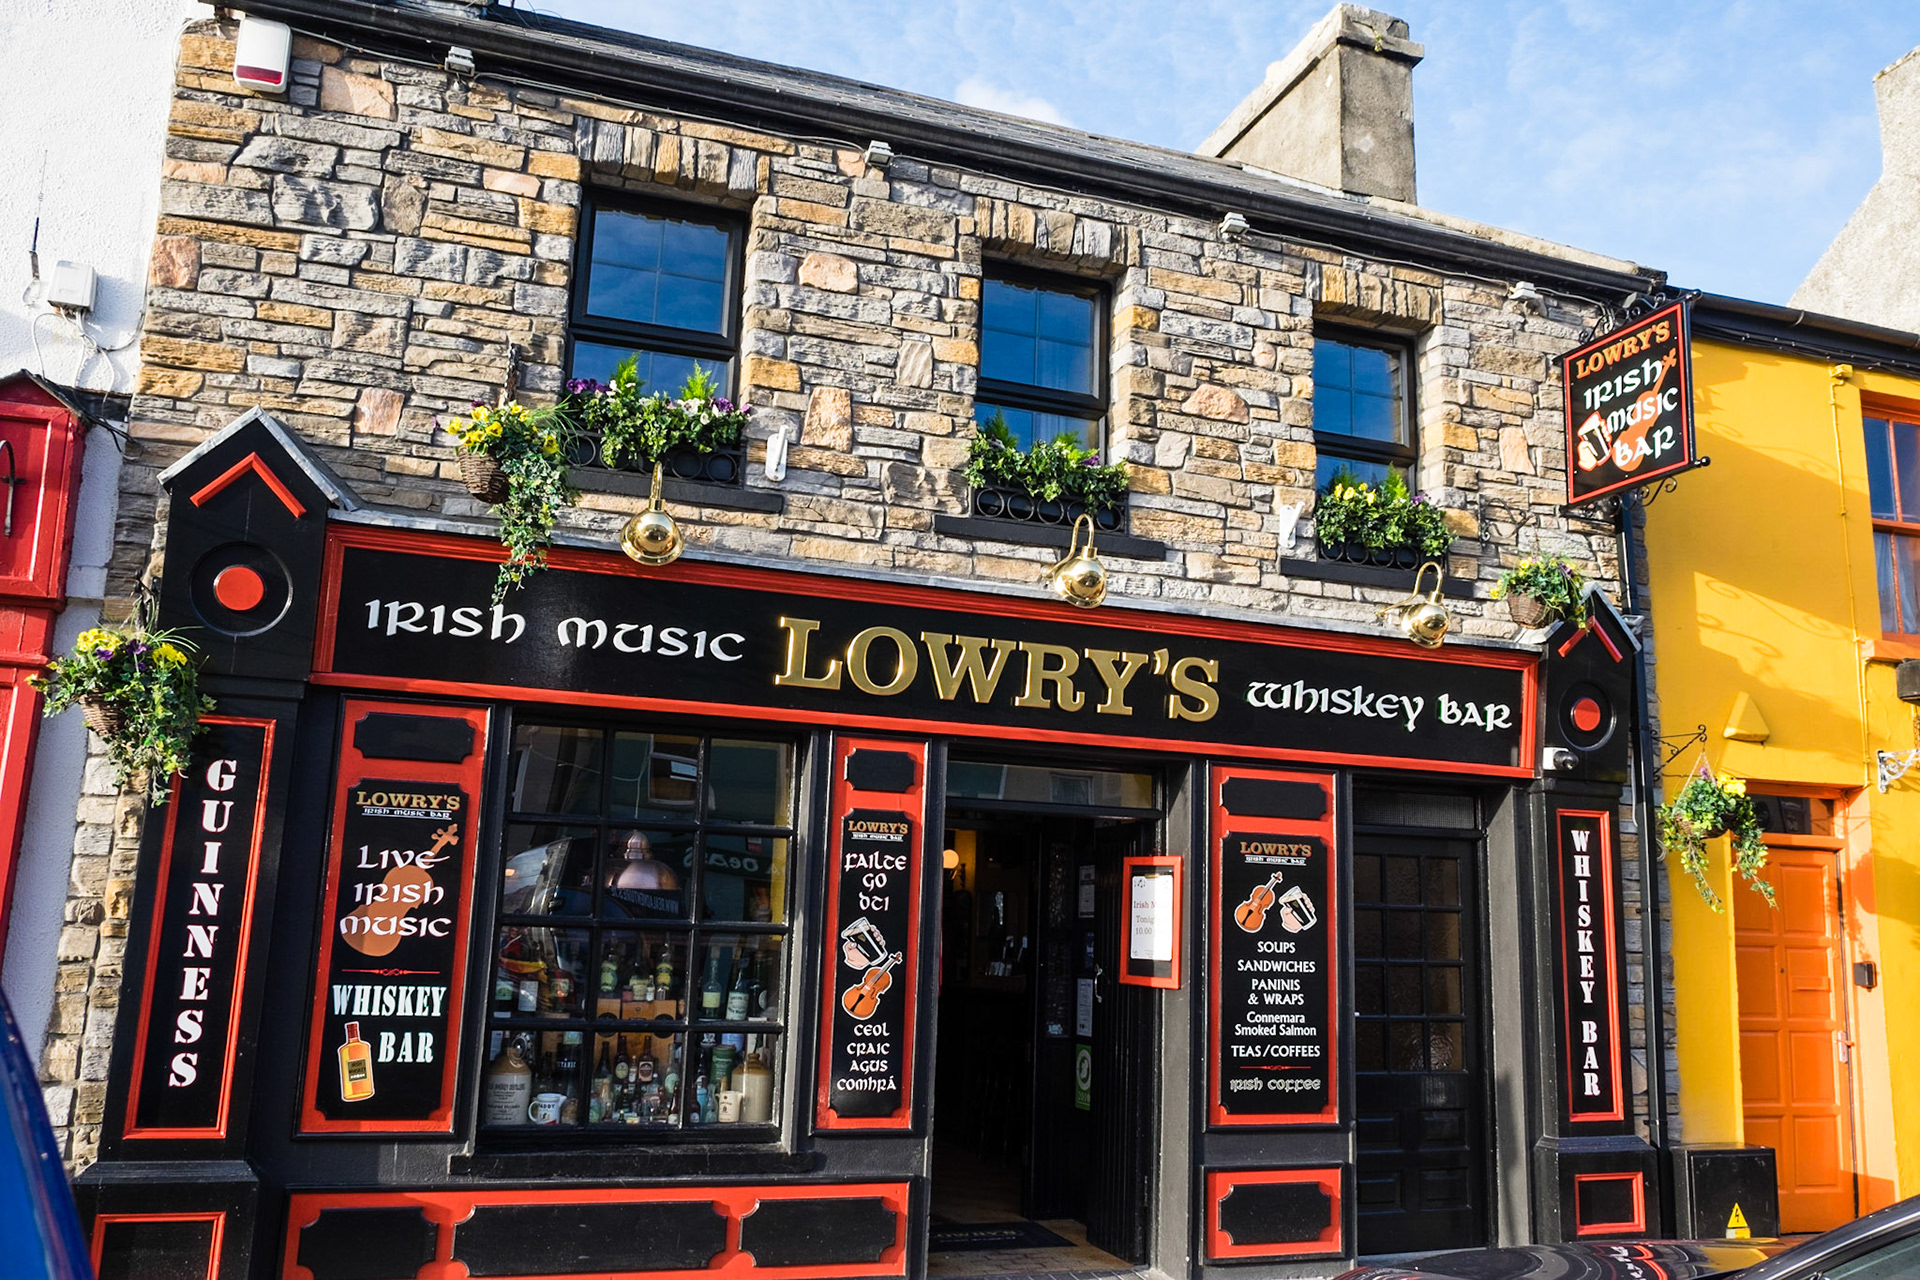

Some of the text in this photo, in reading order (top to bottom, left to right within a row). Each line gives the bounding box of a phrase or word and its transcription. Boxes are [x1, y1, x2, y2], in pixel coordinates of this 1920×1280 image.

[1576, 320, 1670, 379] LOWRY'S
[773, 615, 1220, 722] LOWRY'S
[356, 791, 460, 810] LOWRY'S
[848, 820, 908, 834] LOWRY'S
[1240, 842, 1312, 858] LOWRY'S
[168, 759, 238, 1087] GUINNESS
[1257, 941, 1296, 953] SOUPS
[1237, 959, 1316, 973] SANDWICHES
[1570, 830, 1600, 1096] WHISKEY BAR
[1252, 979, 1300, 991] PANINIS
[332, 985, 447, 1017] WHISKEY
[1248, 993, 1304, 1005] & WRAPS
[1246, 1011, 1305, 1024] Connemara
[1234, 1024, 1317, 1036] Smoked Salmon
[378, 1032, 434, 1063] BAR
